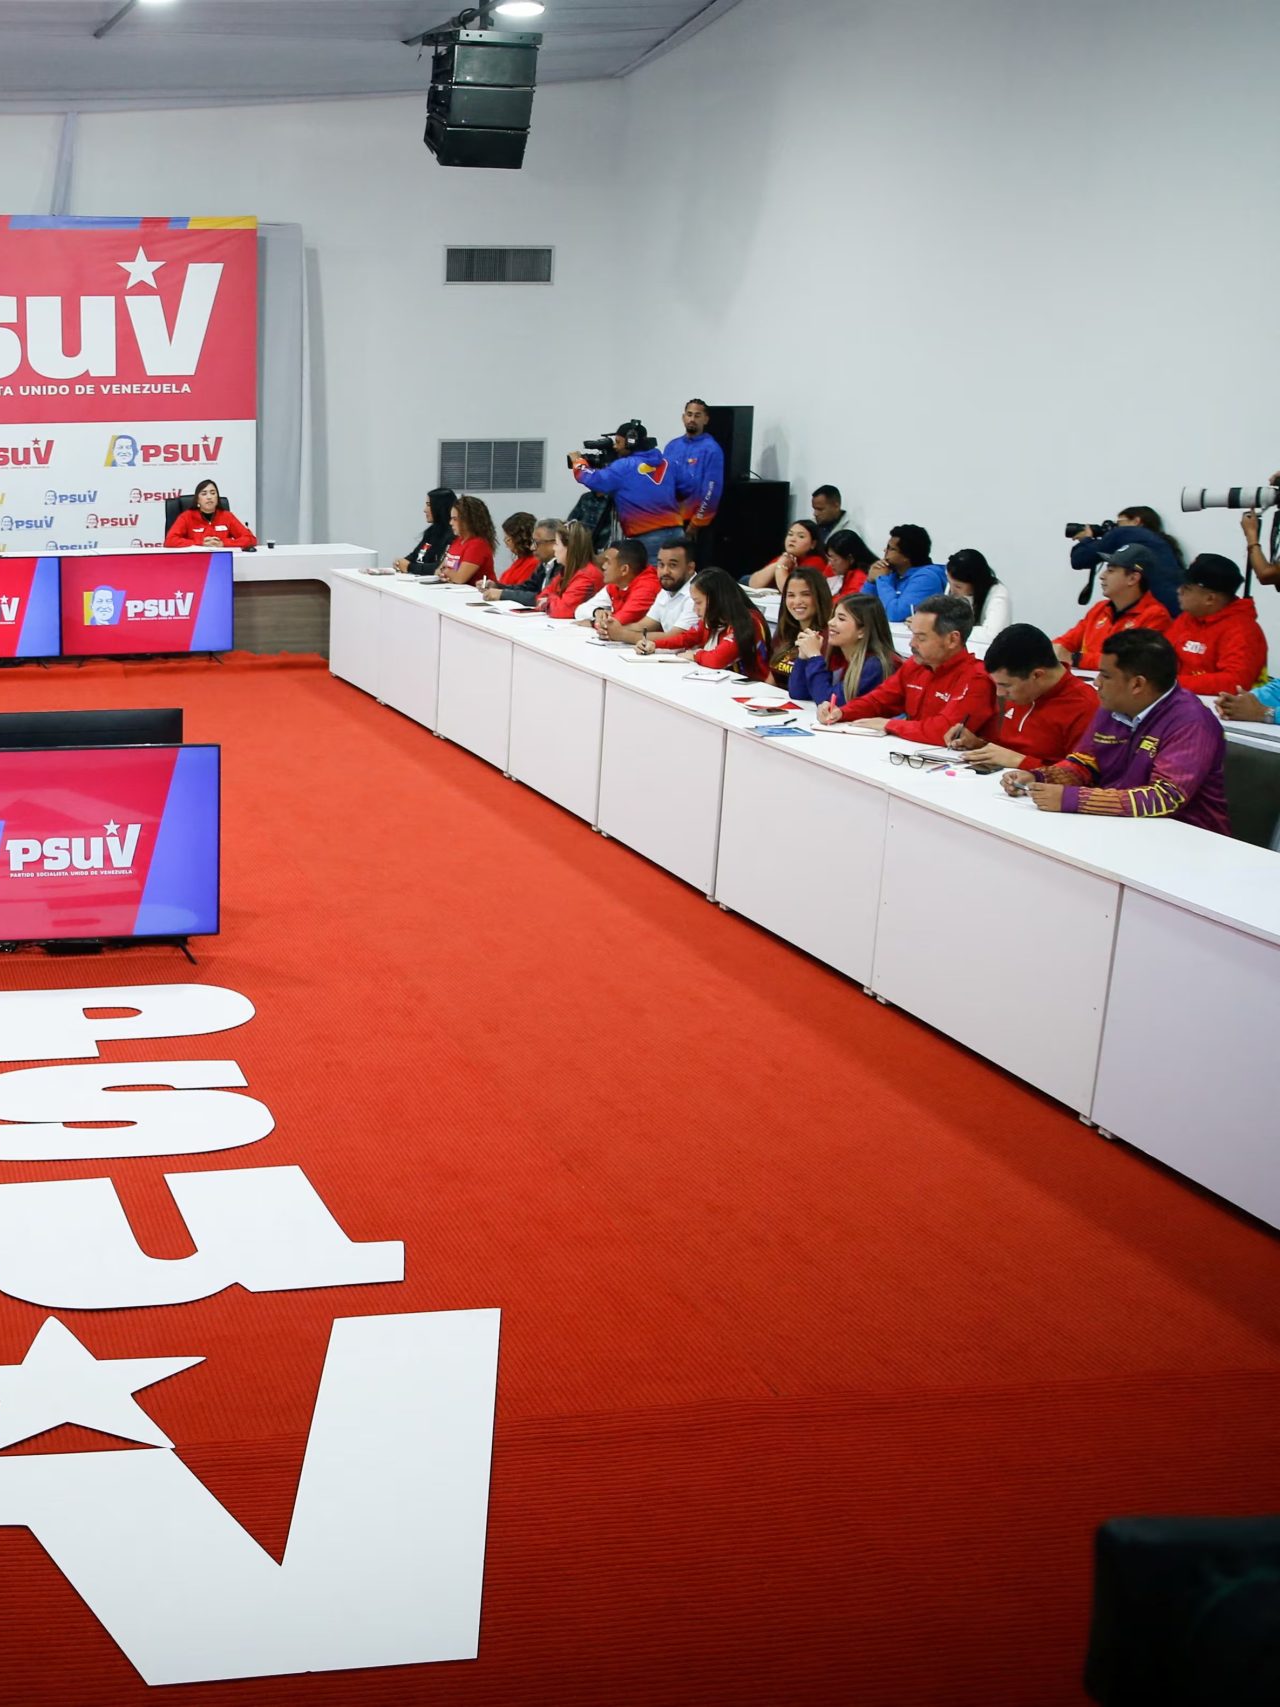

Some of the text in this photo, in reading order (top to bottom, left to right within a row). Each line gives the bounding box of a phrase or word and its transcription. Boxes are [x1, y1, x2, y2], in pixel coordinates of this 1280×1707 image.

[18, 384, 70, 397] UNIDO
[74, 384, 95, 396] DE
[100, 382, 192, 395] VENEZUELA
